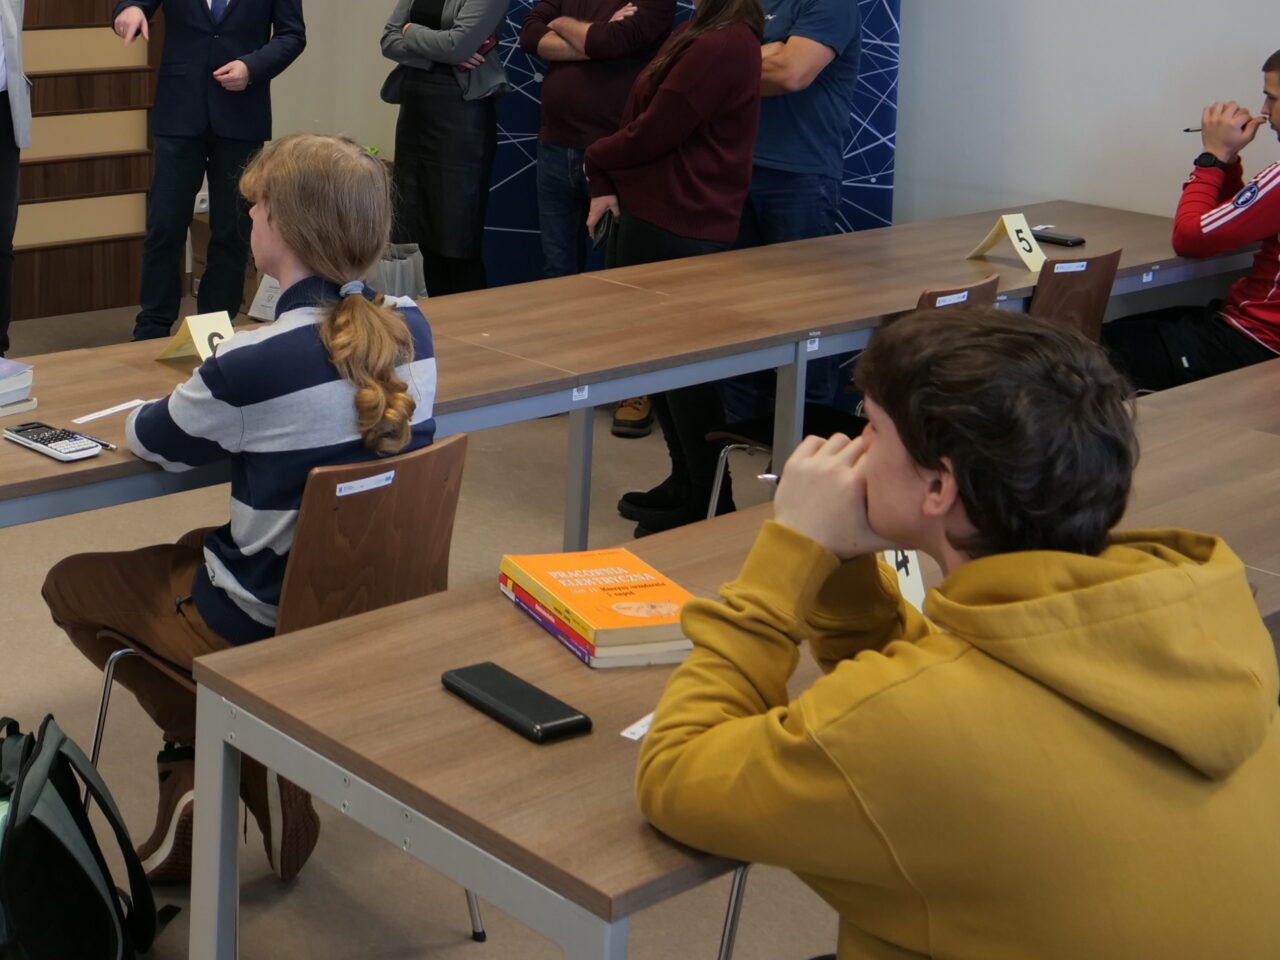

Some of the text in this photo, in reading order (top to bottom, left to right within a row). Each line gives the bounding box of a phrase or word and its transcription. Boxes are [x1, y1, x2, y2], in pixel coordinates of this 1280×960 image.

[1015, 229, 1033, 254] 5
[894, 549, 910, 577] 4
[547, 567, 629, 579] PRACOWNIA
[558, 573, 656, 587] ELEKTRYCZNA
